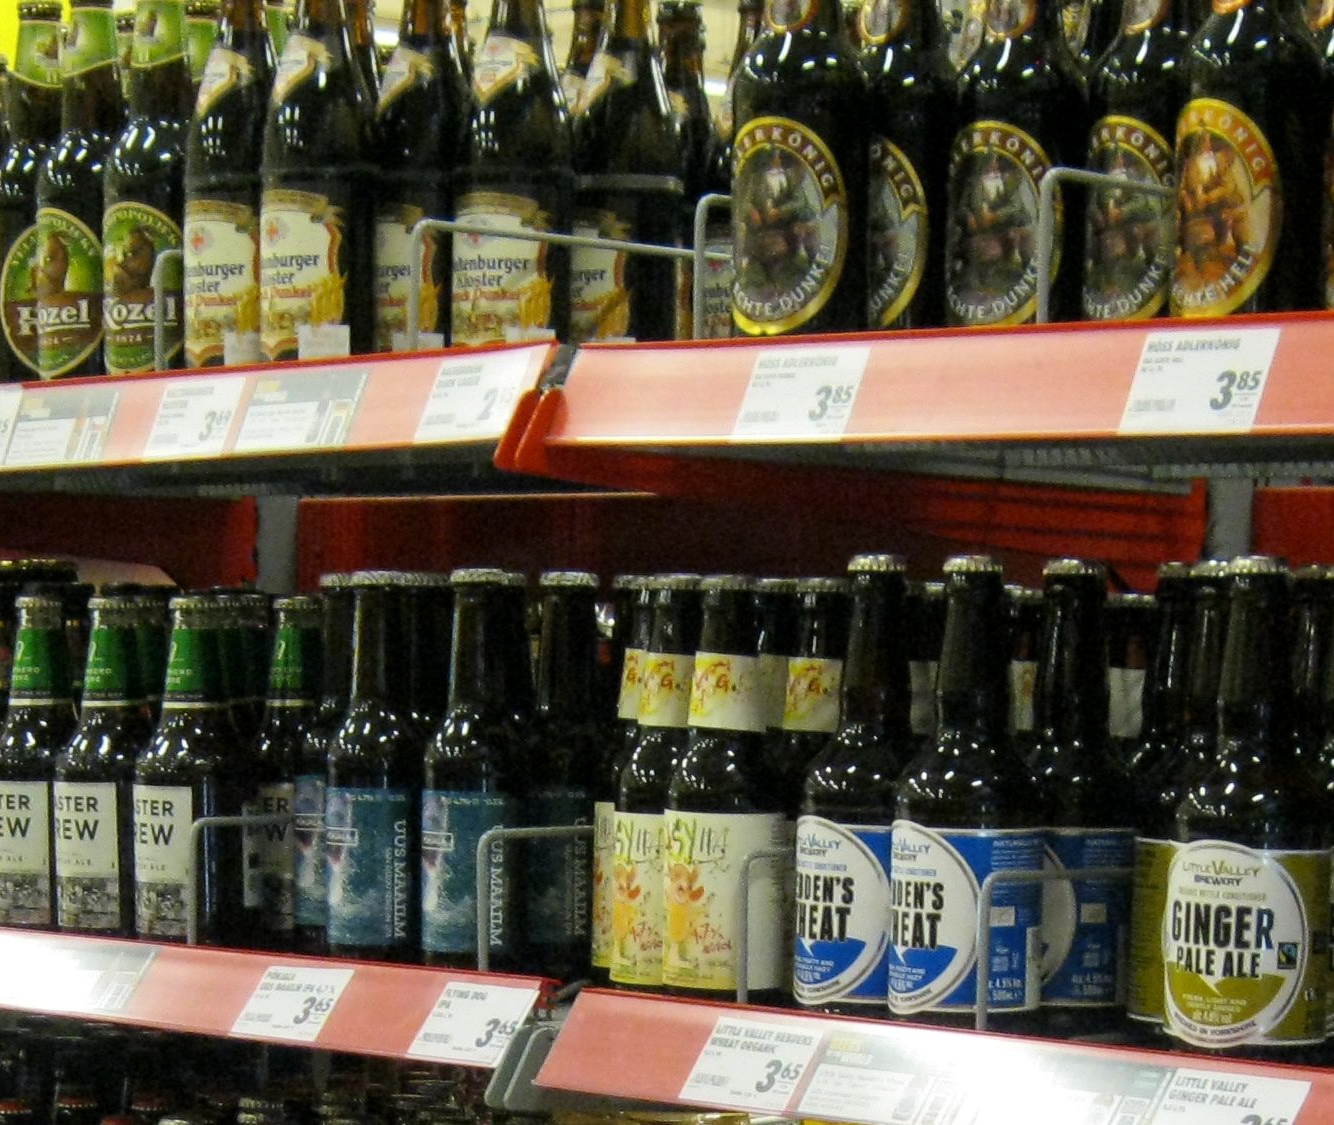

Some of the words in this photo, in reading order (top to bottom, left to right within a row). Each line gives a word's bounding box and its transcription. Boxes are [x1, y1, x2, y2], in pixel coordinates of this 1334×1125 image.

[1212, 859, 1261, 877] VALLEY
[1171, 900, 1275, 950] GINGER
[1176, 946, 1215, 978] PALE
[1222, 951, 1261, 979] ALE
[1175, 1077, 1208, 1092] LITTLE
[1210, 1079, 1249, 1095] VALLEY
[1168, 1089, 1208, 1105] GINGER
[1210, 1092, 1237, 1107] PALE
[1238, 1096, 1259, 1110] ALE
